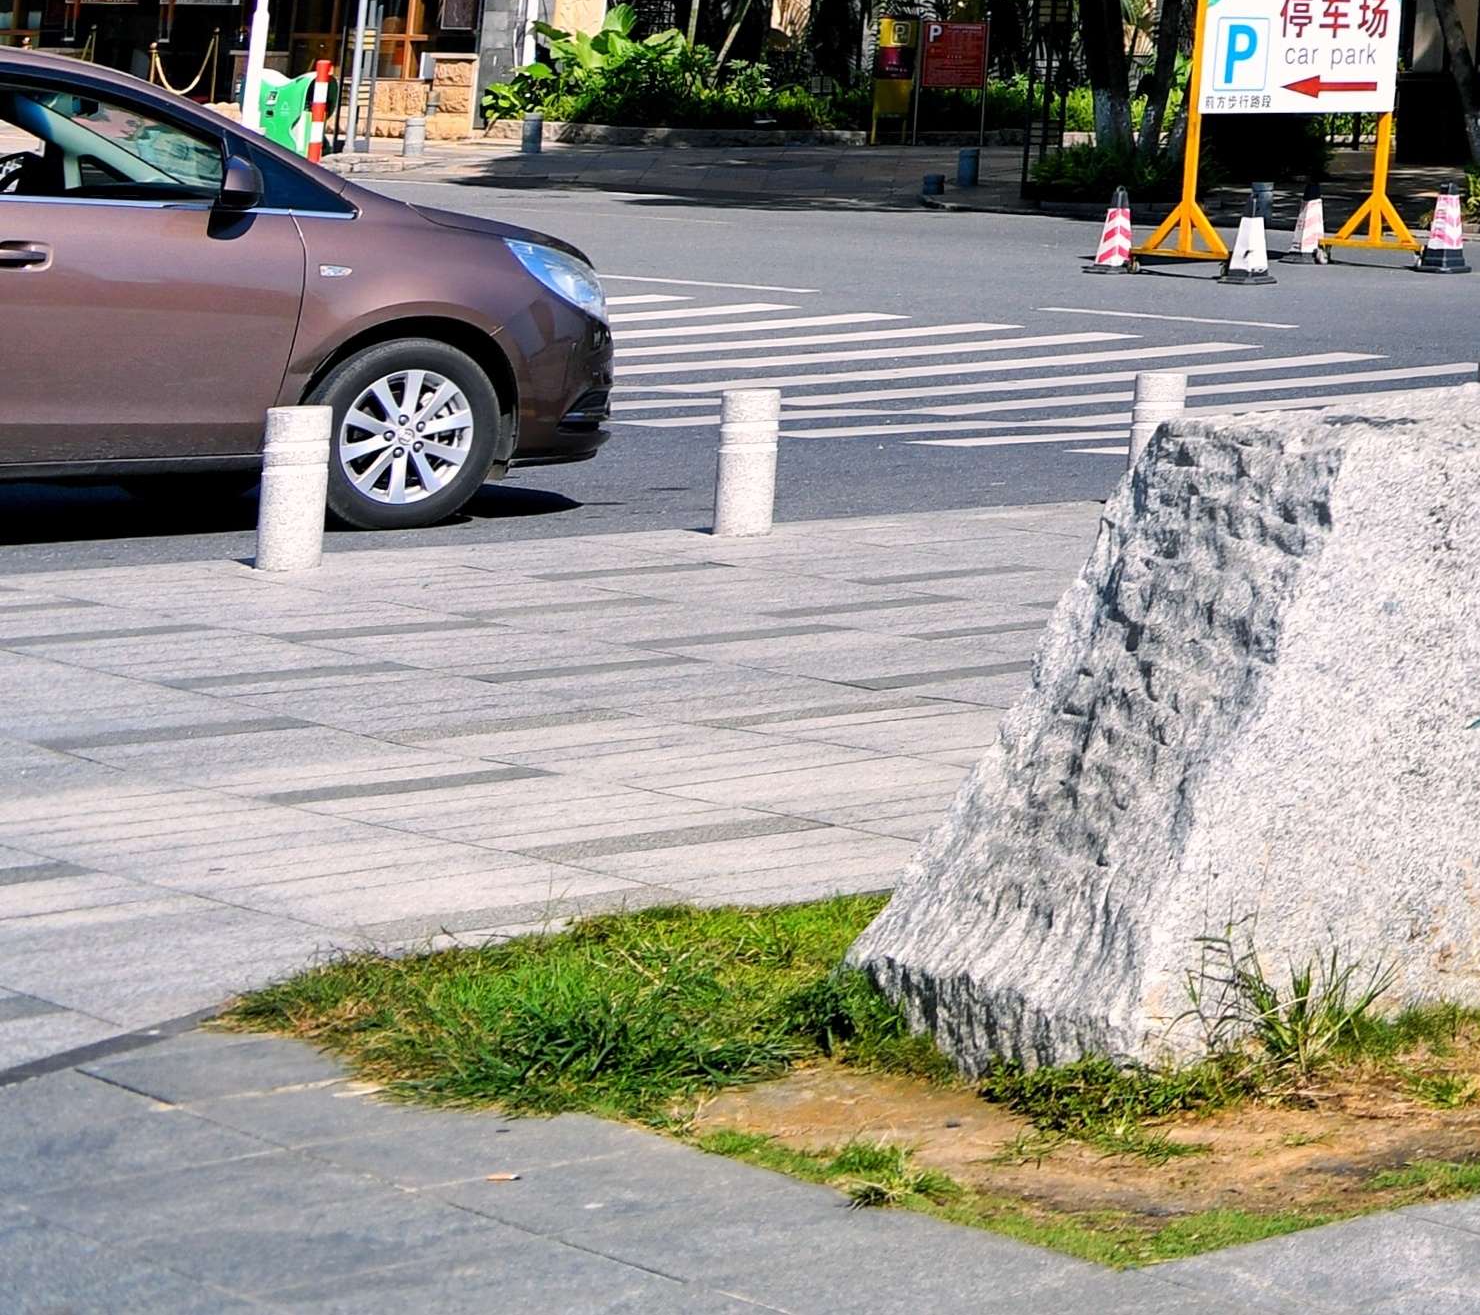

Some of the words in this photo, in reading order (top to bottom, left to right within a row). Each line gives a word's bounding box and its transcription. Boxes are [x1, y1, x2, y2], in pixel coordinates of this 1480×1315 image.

[1224, 24, 1258, 84] P
[1285, 47, 1319, 65] car
[1331, 43, 1377, 70] park
[1205, 95, 1272, 109] 前方步行路段
